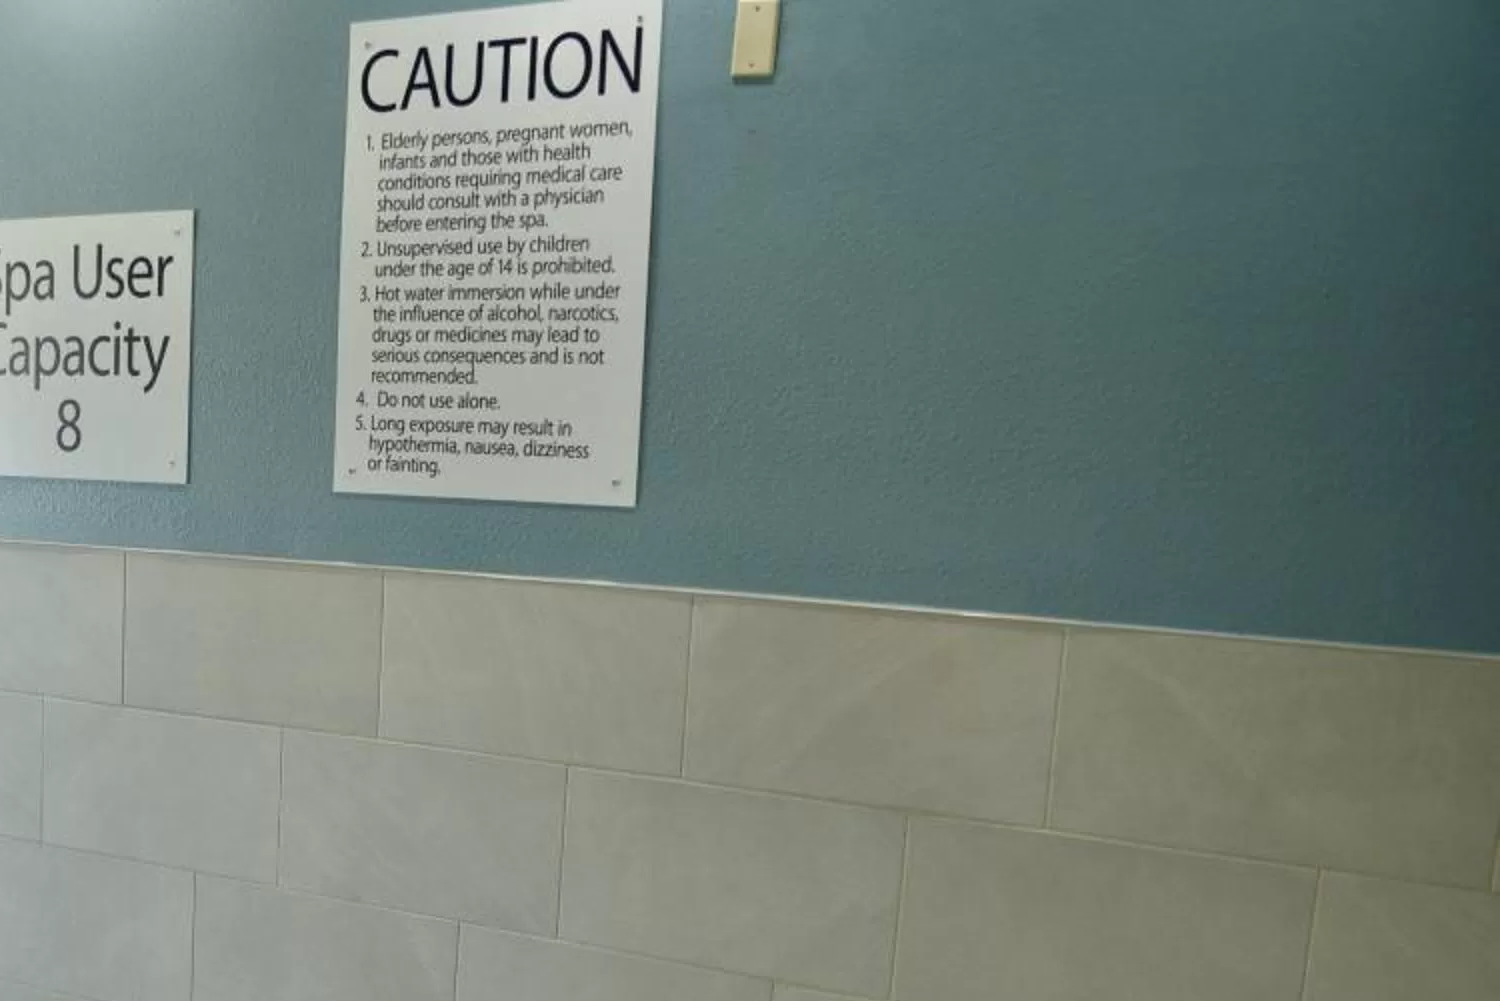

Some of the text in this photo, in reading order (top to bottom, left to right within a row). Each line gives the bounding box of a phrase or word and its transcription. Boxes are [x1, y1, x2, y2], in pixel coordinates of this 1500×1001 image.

[361, 26, 643, 113] CAUTION
[381, 131, 429, 152] Elderly
[431, 129, 492, 151] persons,
[496, 124, 565, 146] pregnant
[569, 121, 633, 139] women,
[379, 141, 591, 171] infants and those with health
[377, 164, 623, 192] conditions requiring medical care
[376, 187, 605, 212] should consult with a physician
[375, 211, 549, 235] before entering the spa.
[361, 234, 590, 260] 2. Unsupervised use by children
[72, 243, 176, 300] User
[375, 255, 617, 281] under the age of 14 is prohibited.
[359, 280, 622, 303] 3. Hot water immersion while under
[373, 303, 619, 324] the influence of alcohol, narcotics,
[371, 326, 601, 348] drugs or medicines may lead to
[371, 346, 605, 374] serious consequences and is not
[371, 365, 479, 385] recommended.
[377, 390, 398, 408] Do
[400, 392, 427, 409] not
[428, 395, 454, 409] use
[457, 392, 501, 410] alone.
[56, 399, 84, 454] 8
[355, 414, 574, 440] 5. Long exposure may result in
[368, 433, 591, 459] hypothermia, nausea, dizziness
[367, 455, 441, 478] or fainting.
